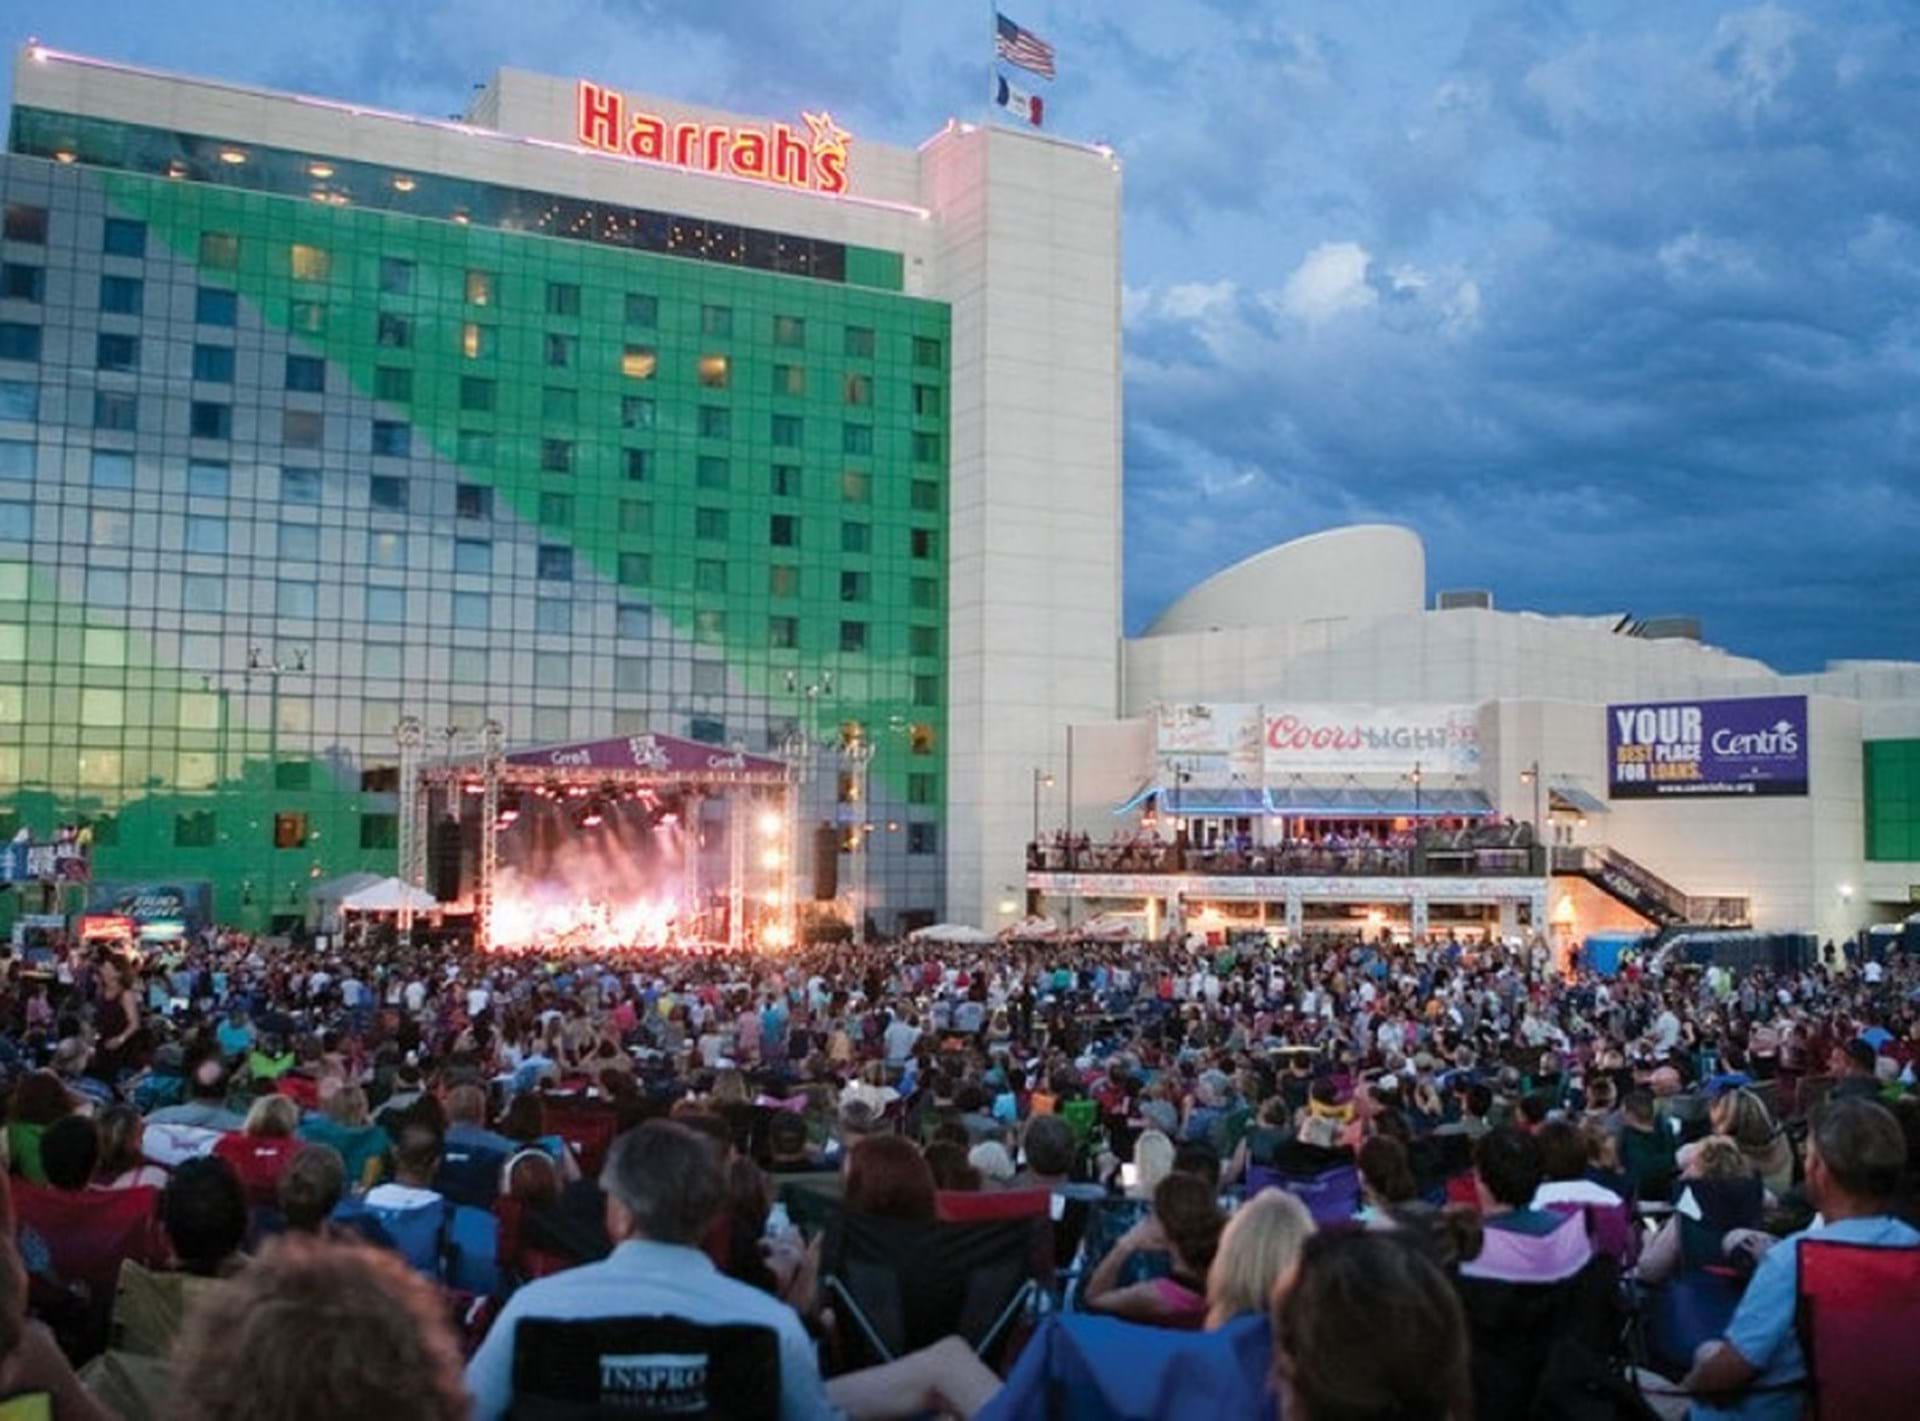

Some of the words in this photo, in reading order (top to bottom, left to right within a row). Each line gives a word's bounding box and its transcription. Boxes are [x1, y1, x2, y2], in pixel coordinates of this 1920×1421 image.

[1266, 714, 1363, 749] Coors
[1367, 726, 1447, 750] LIGHT
[1616, 706, 1702, 744] YOUR
[1711, 720, 1798, 755] Centris
[1655, 743, 1702, 762] PLACE
[1616, 763, 1646, 781] FOR
